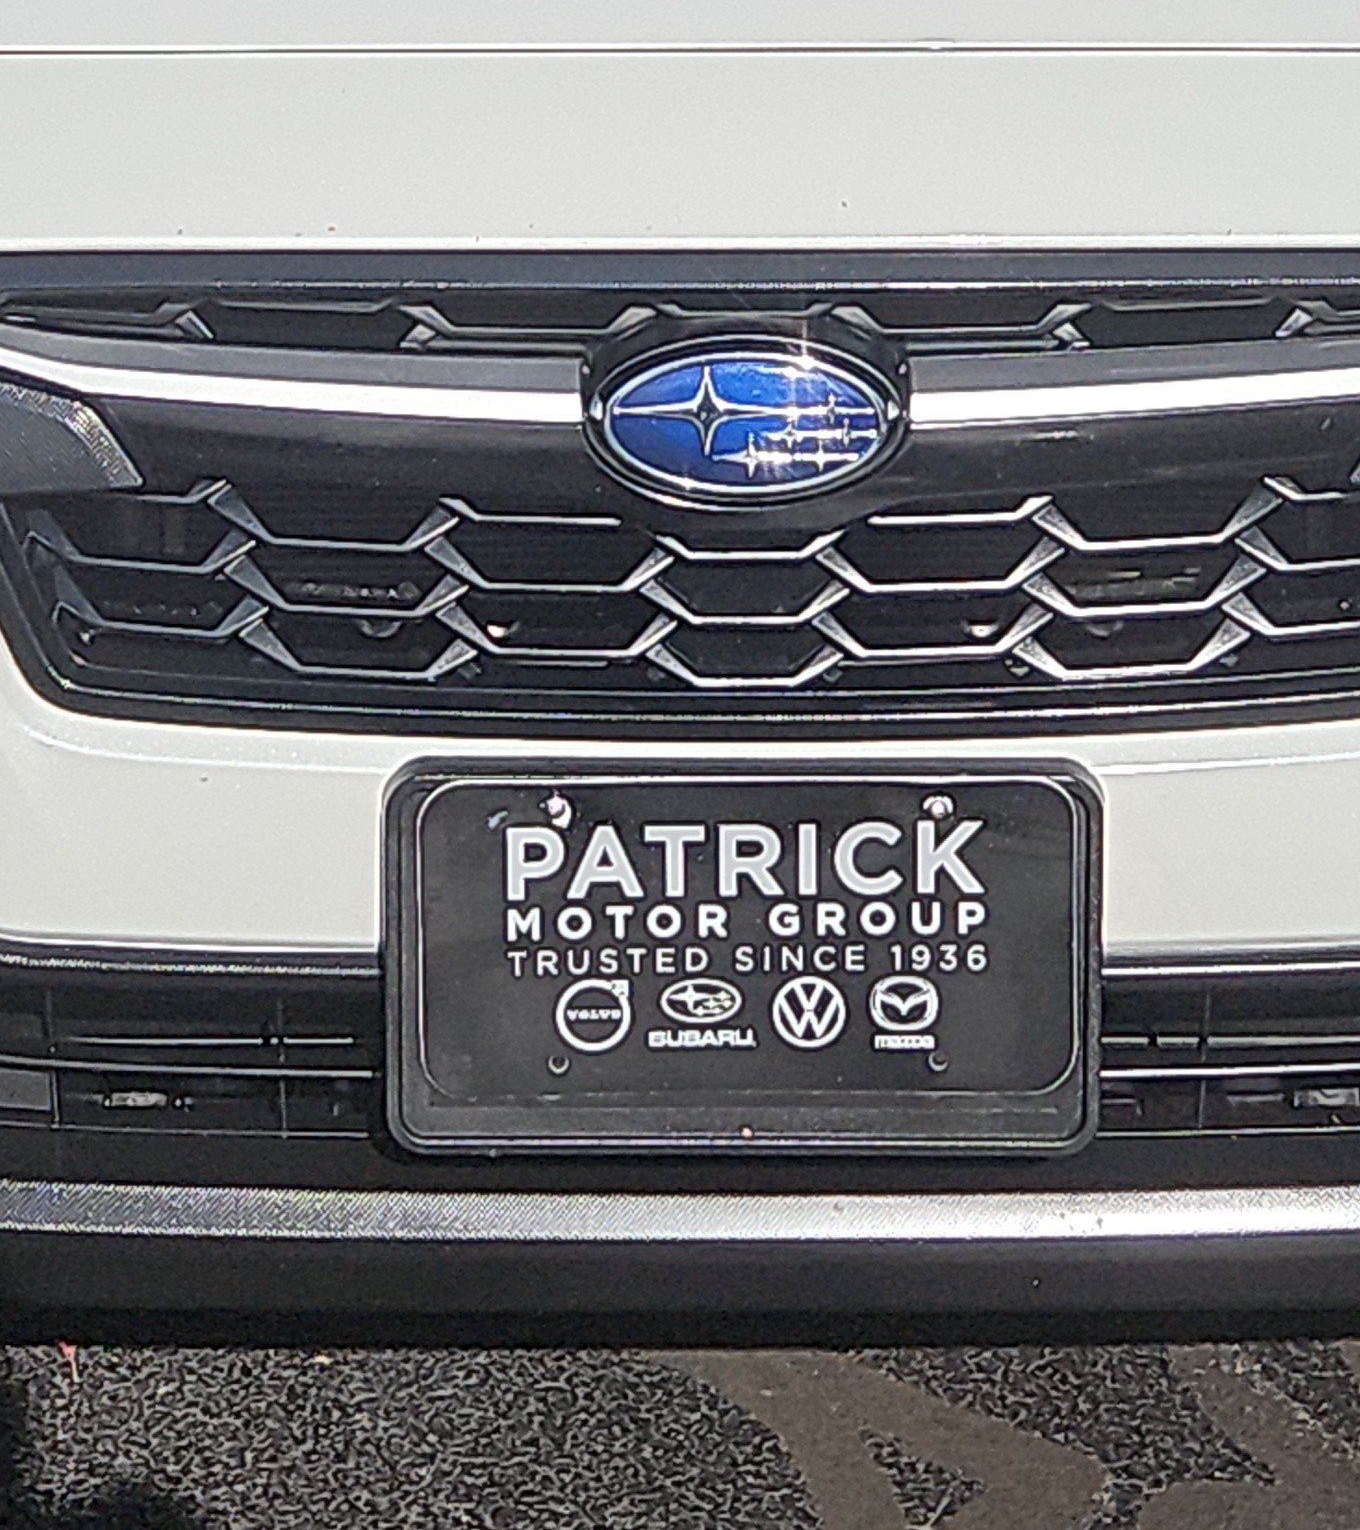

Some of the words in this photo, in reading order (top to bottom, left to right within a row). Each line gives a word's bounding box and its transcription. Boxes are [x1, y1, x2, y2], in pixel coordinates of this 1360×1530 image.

[504, 819, 987, 900] PATRICK
[506, 904, 729, 942] MOTOR
[768, 901, 989, 938] GROUP
[507, 947, 710, 977] TRUSTED
[734, 945, 867, 972] SINCE
[890, 943, 989, 972] 1936
[648, 1029, 755, 1049] SUBARU
